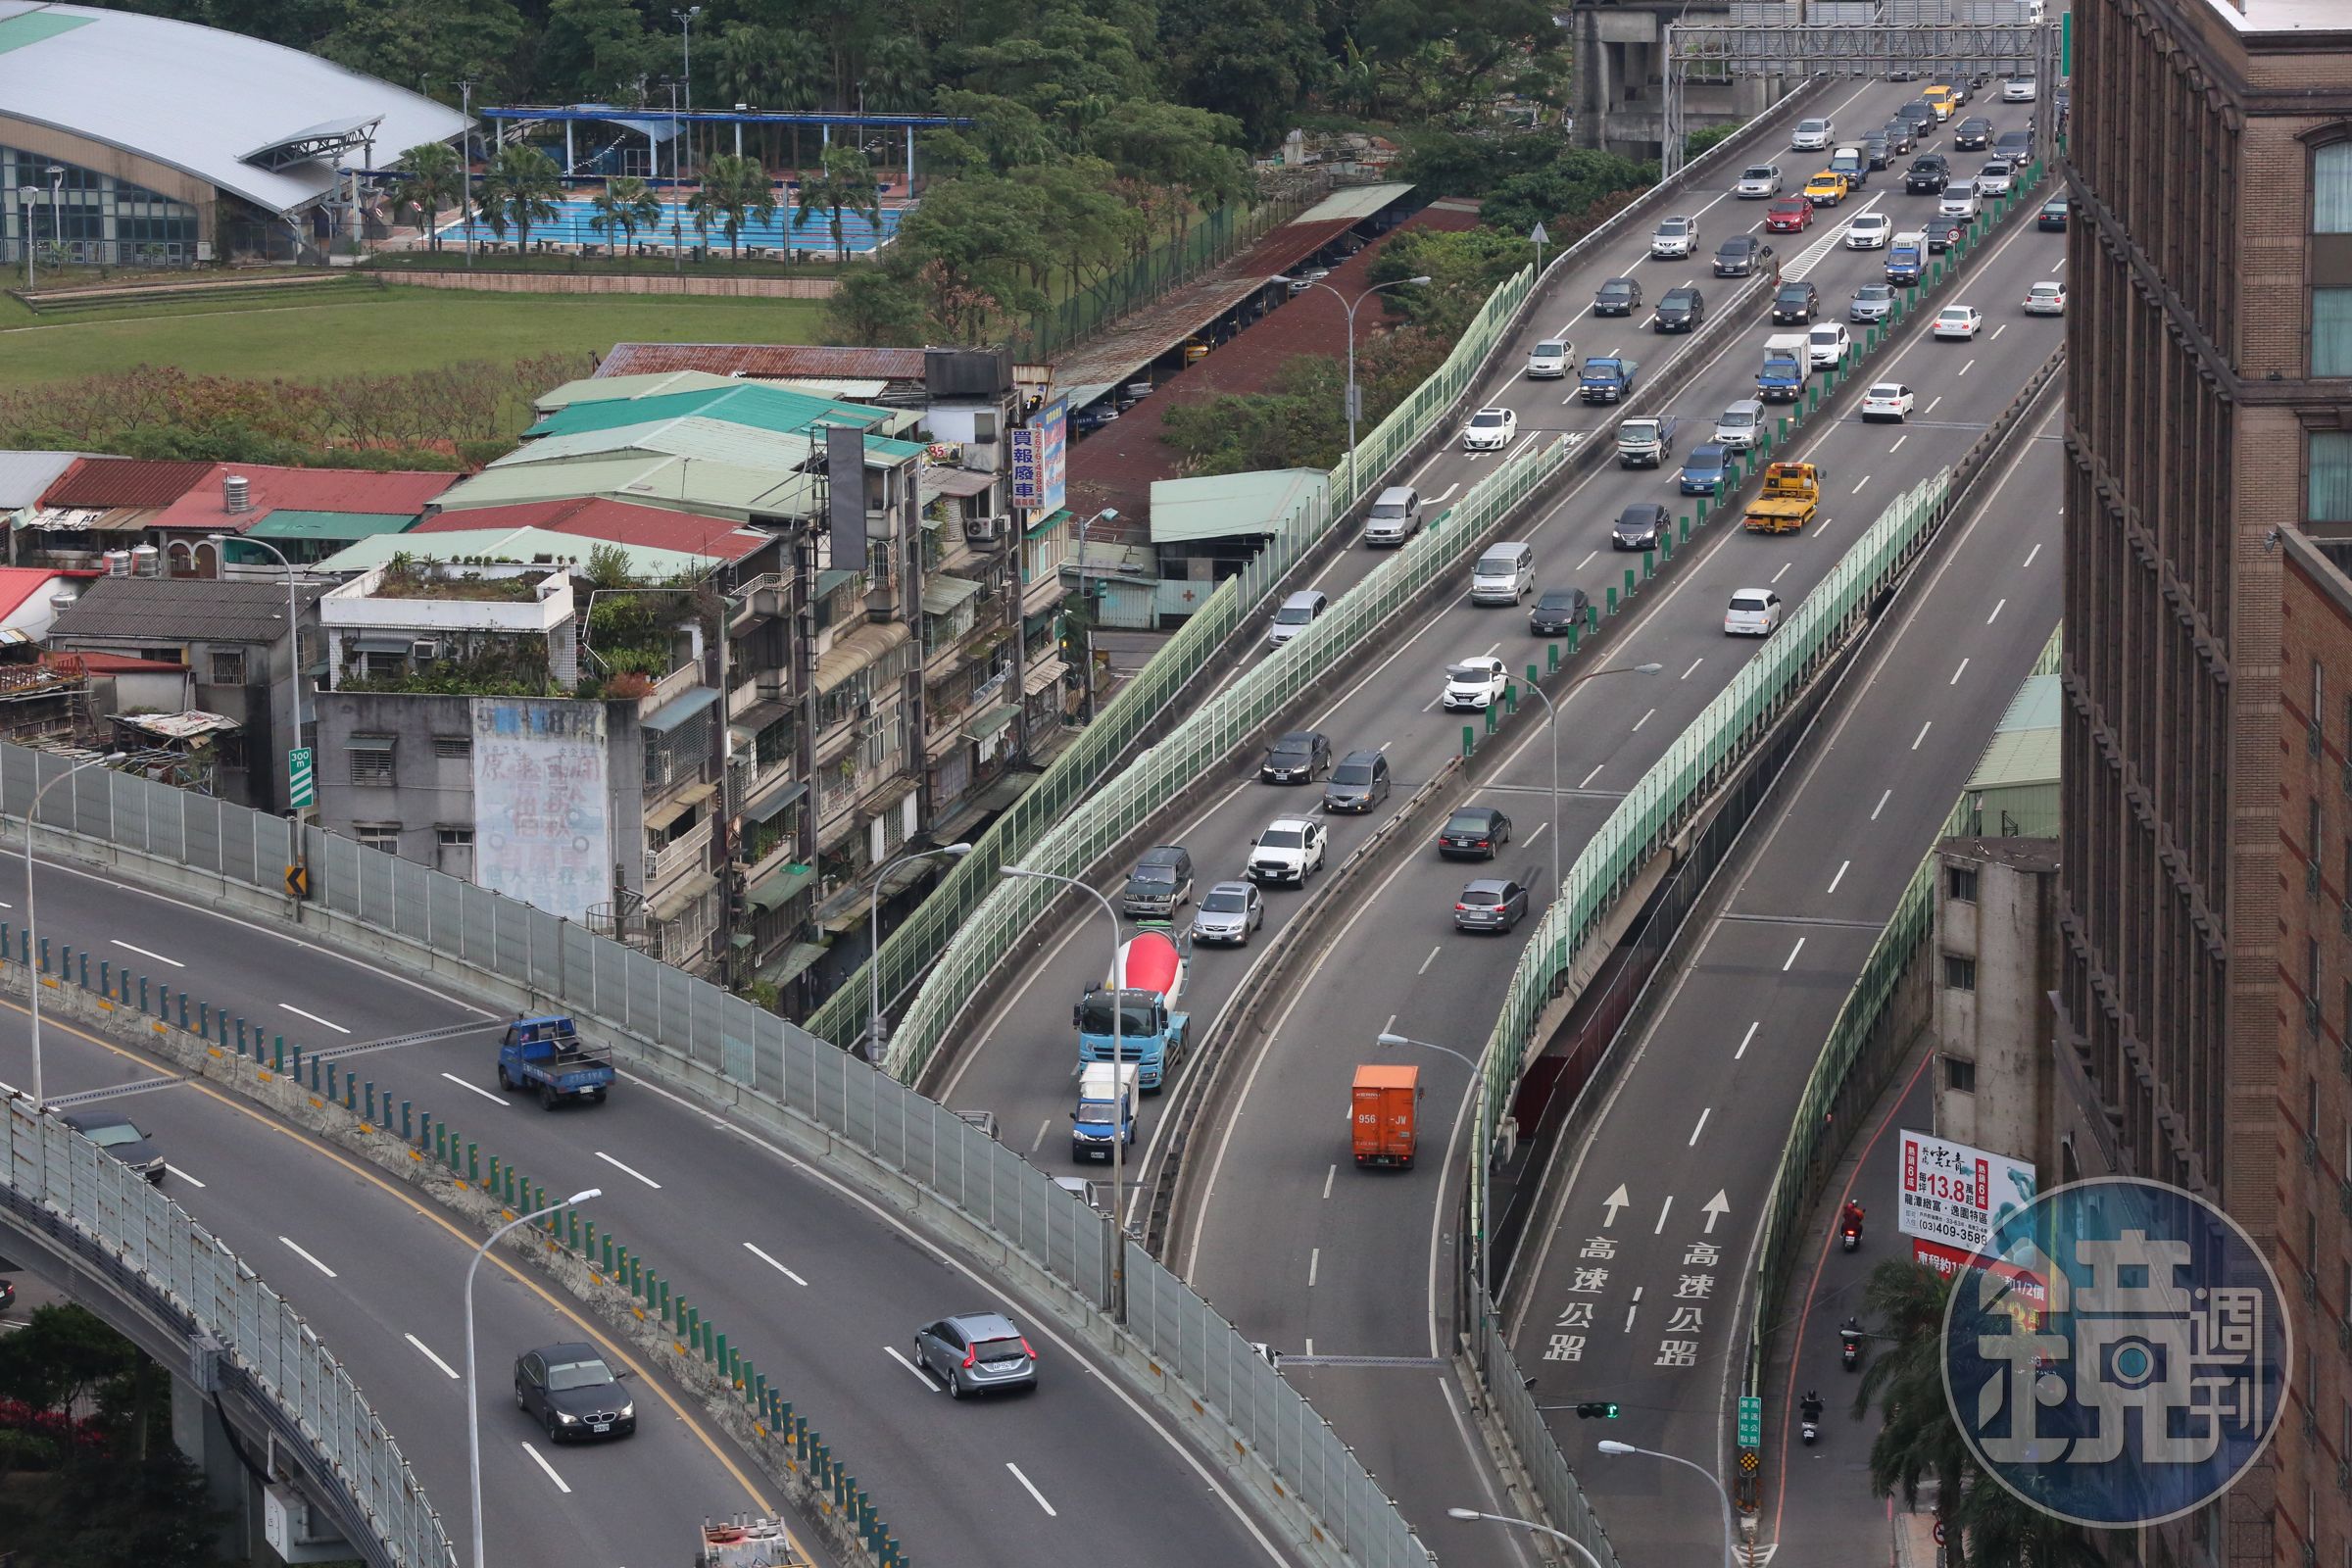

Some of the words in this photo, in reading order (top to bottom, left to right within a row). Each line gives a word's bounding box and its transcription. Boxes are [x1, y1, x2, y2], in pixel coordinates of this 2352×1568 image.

[1013, 431, 1035, 497] 買報廢車
[291, 751, 310, 761] 300
[1358, 1114, 1376, 1124] 956
[1927, 1173, 1965, 1202] 13.8
[1919, 1219, 1987, 1246] (03)409-3588
[1543, 1236, 1618, 1362] 高速公路
[1654, 1242, 1722, 1367] 高速公路
[1750, 1400, 1759, 1444] 高速公路
